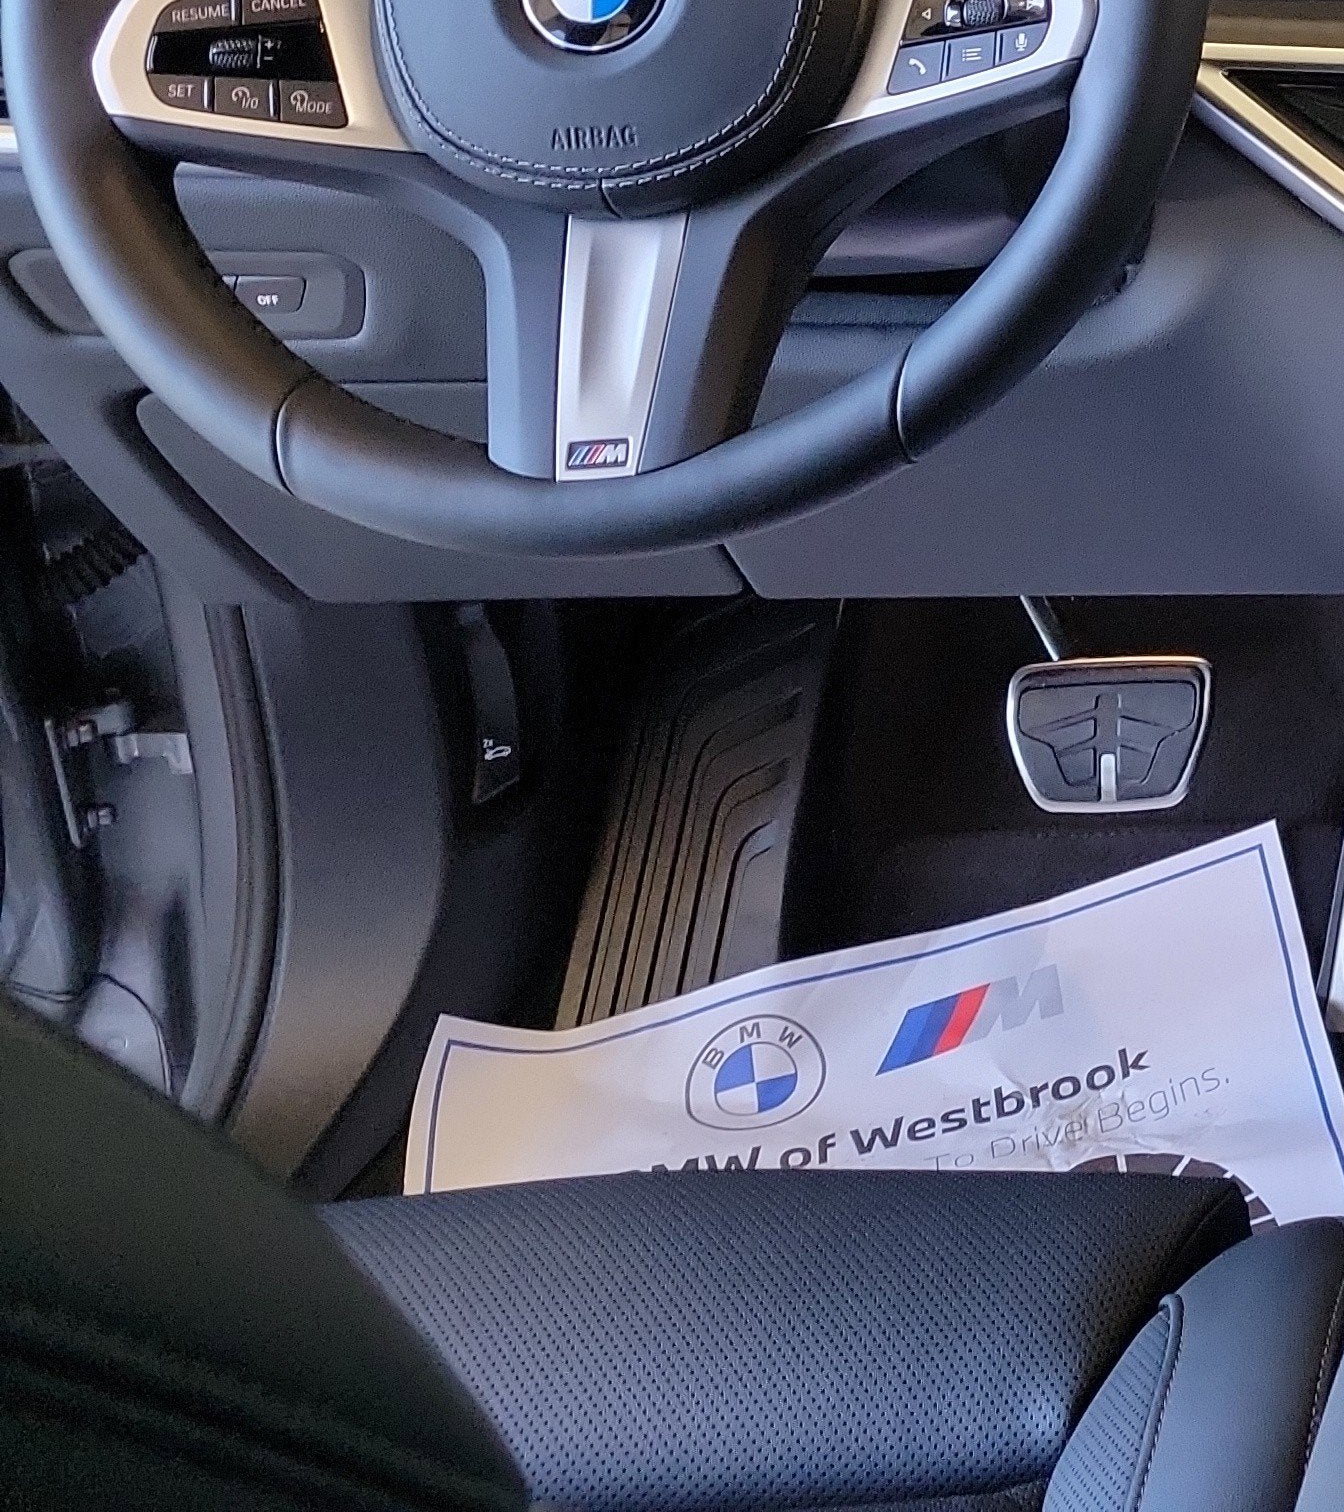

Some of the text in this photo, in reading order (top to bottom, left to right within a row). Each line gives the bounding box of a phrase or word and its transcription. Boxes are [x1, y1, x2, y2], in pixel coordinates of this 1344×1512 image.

[171, 2, 230, 24] RESUME
[167, 83, 196, 99] SET
[295, 99, 334, 115] MODE
[550, 124, 639, 152] AIRBAG
[256, 294, 279, 306] OFF
[702, 1021, 804, 1070] BMW
[779, 1047, 1152, 1171] of Westbrook
[923, 1065, 1232, 1172] To Drive Begins.
